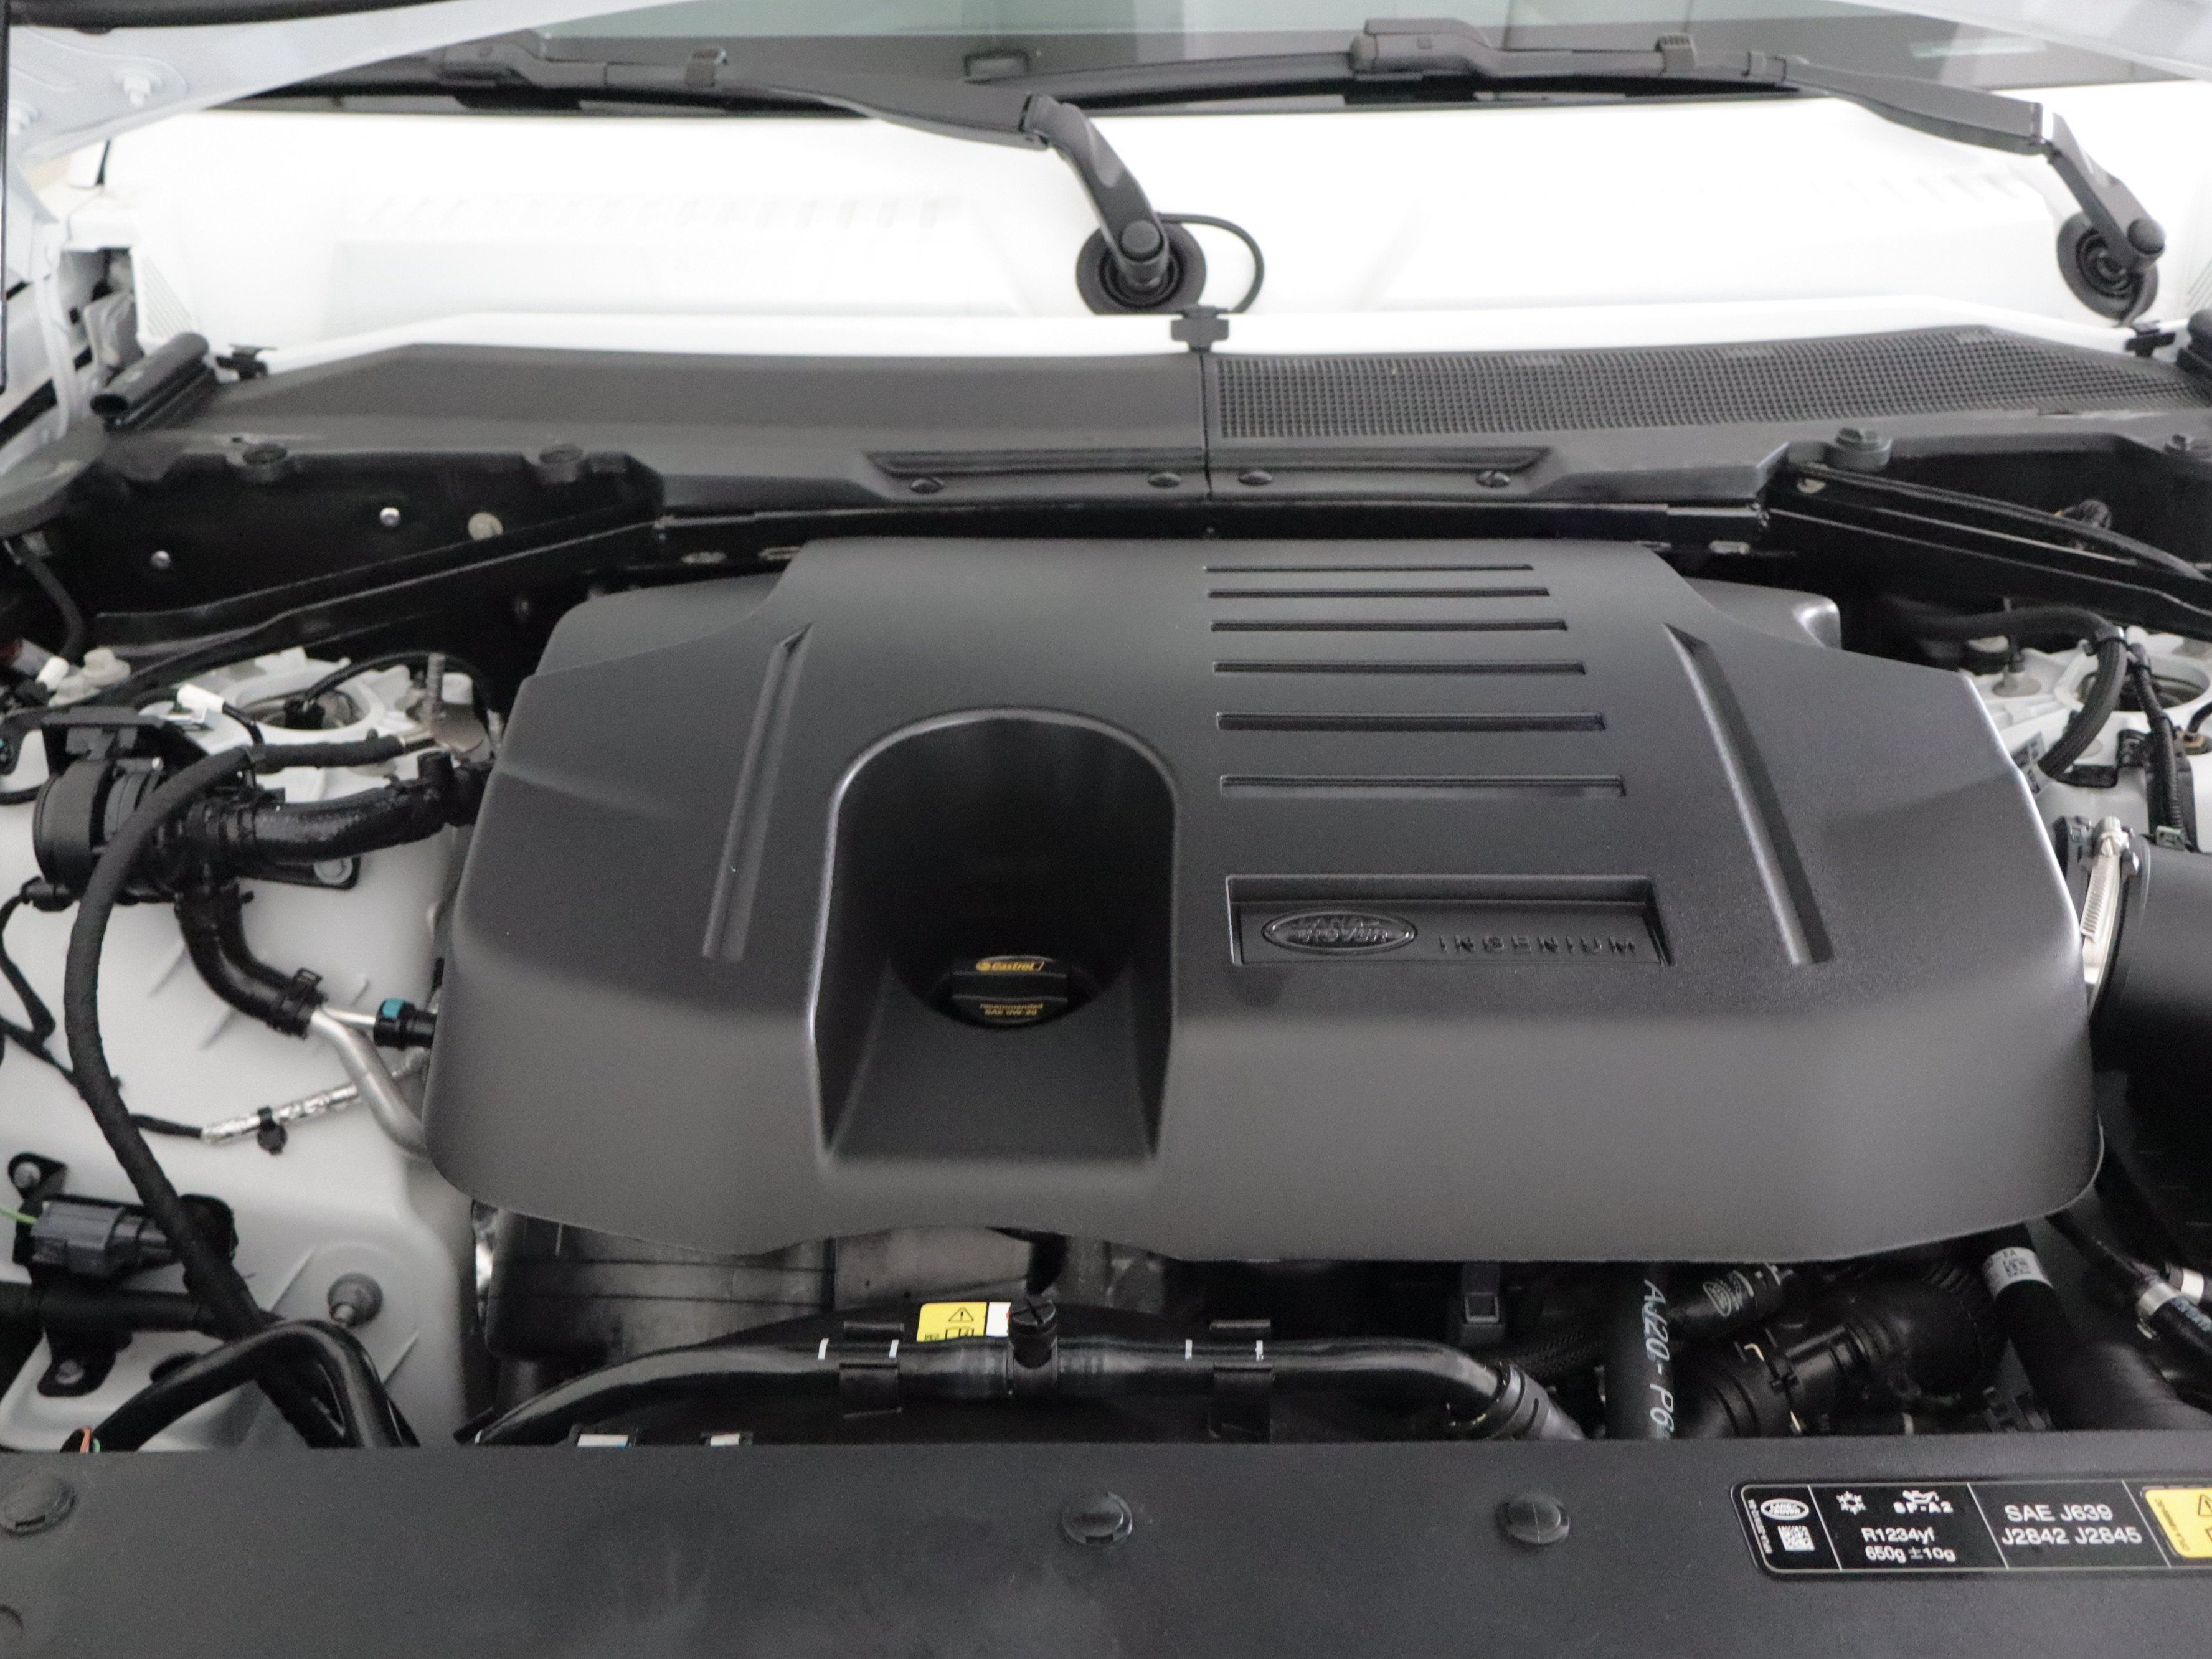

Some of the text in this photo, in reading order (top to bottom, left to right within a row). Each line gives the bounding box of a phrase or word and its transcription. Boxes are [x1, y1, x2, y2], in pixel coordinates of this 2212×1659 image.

[1439, 933, 1636, 954] INGENIUM
[2004, 1503, 2113, 1523] SAE J639
[1861, 1526, 1936, 1545] R1234yf
[2001, 1526, 2142, 1545] J2842 J2845
[1865, 1545, 1907, 1564] 650g
